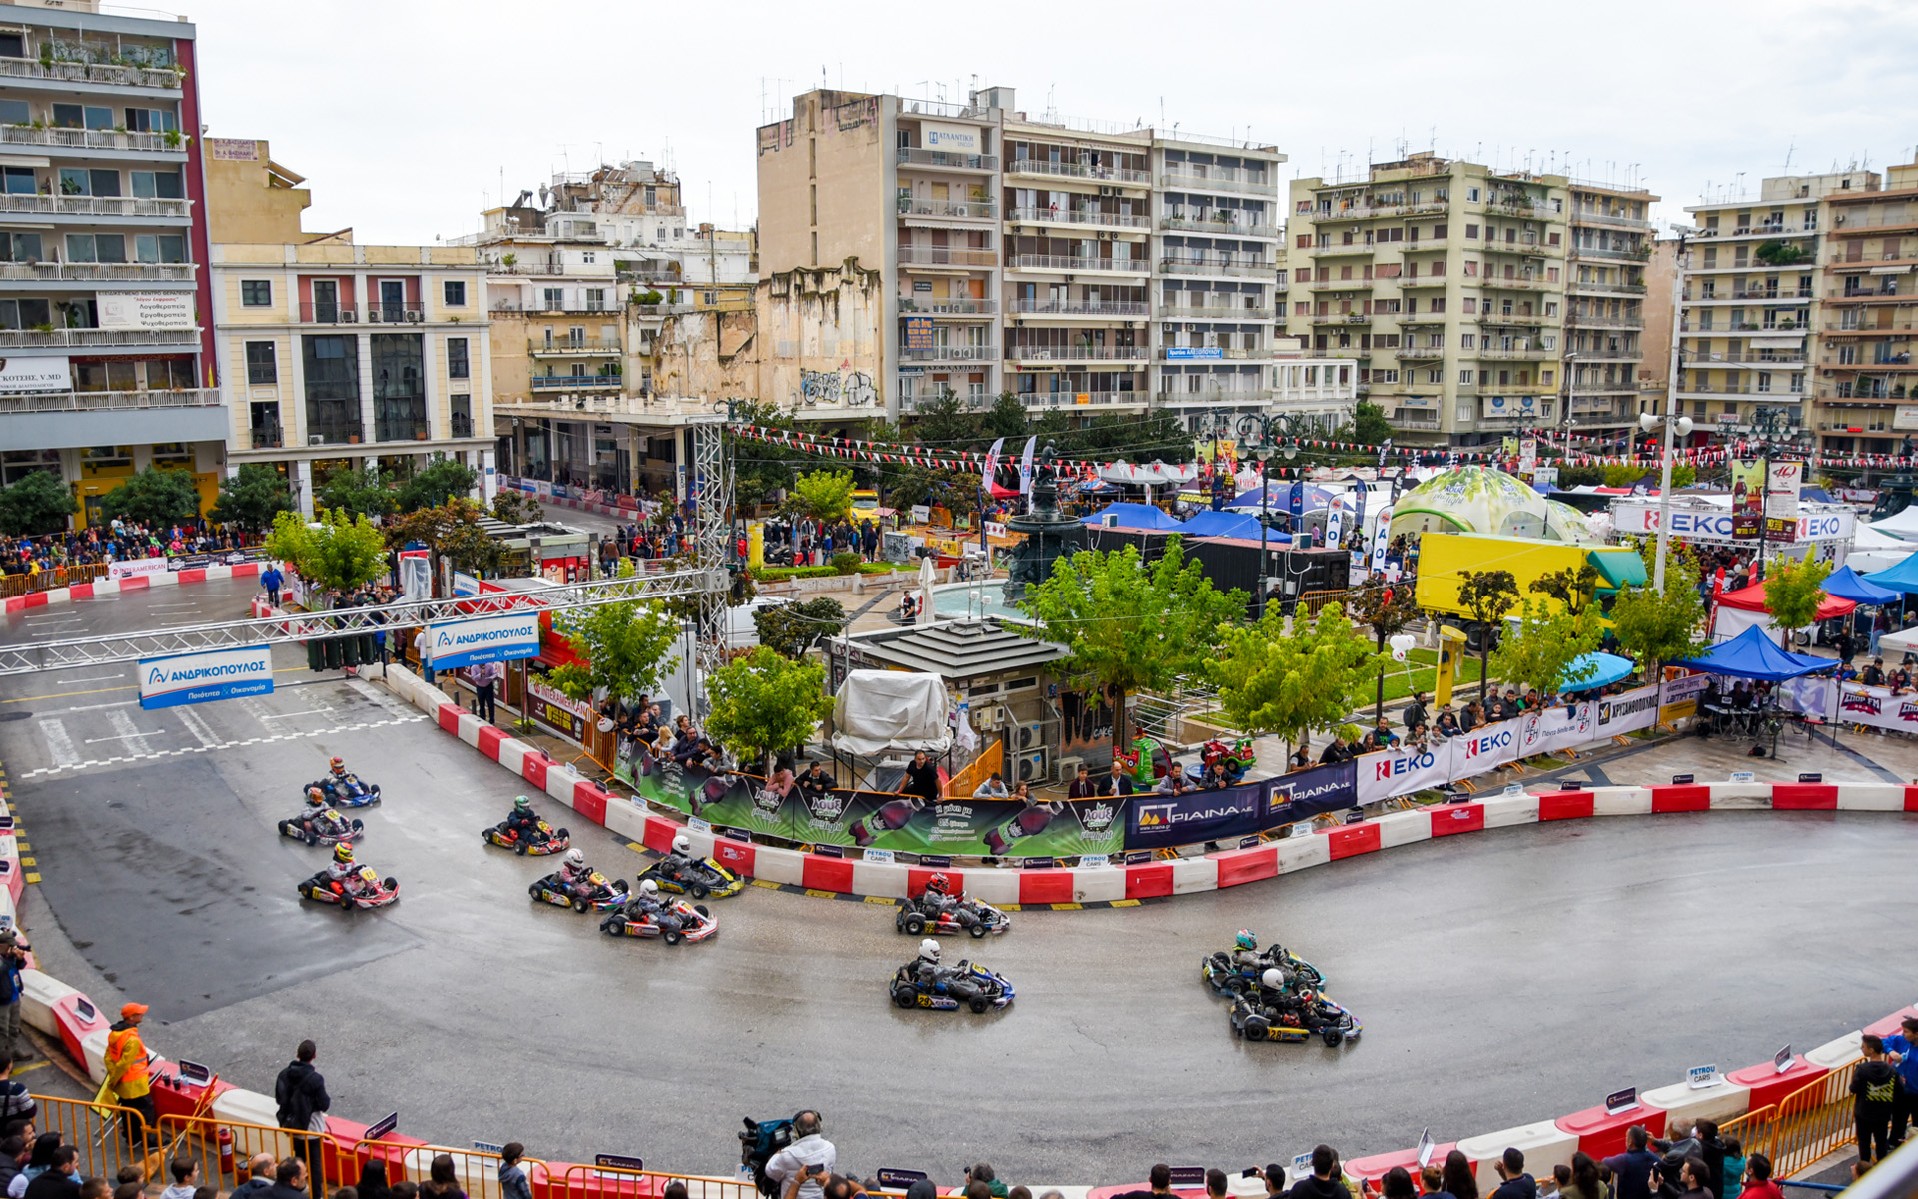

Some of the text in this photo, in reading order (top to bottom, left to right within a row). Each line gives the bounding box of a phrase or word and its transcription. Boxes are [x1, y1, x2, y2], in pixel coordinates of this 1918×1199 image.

[938, 131, 974, 142] ΑΤΛΑΝΤΙΚΗ
[1671, 513, 1733, 535] EKO
[1808, 515, 1840, 536] EKO
[118, 563, 166, 574] INTERAMERICAN
[456, 625, 534, 645] ΑΝΔΡΙΚΟΠΟΥΛΟΣ
[171, 659, 267, 682] ΑΝΔΡΙΚΟΠΟΥΛΟΣ
[188, 688, 221, 700] Ποιότητα
[230, 682, 267, 694] Οικονομία
[1867, 697, 1880, 710] FM
[1480, 729, 1512, 753] EKO
[1394, 750, 1435, 774] EKO
[810, 796, 842, 815] λουξ
[943, 803, 962, 813] μόνη
[962, 806, 973, 815] με
[815, 808, 837, 818] Cola
[1082, 806, 1113, 823] λουξ
[690, 817, 709, 827] PETROU
[692, 823, 705, 831] CARS
[1087, 819, 1108, 828] Cola
[867, 849, 892, 858] PETROU
[870, 855, 887, 863] CARS
[1083, 854, 1106, 862] PETROU
[919, 996, 930, 1007] 29
[1270, 1029, 1282, 1041] 28
[1690, 1065, 1715, 1076] PETROU
[1693, 1073, 1711, 1083] CARS
[475, 1141, 504, 1153] PETRO
